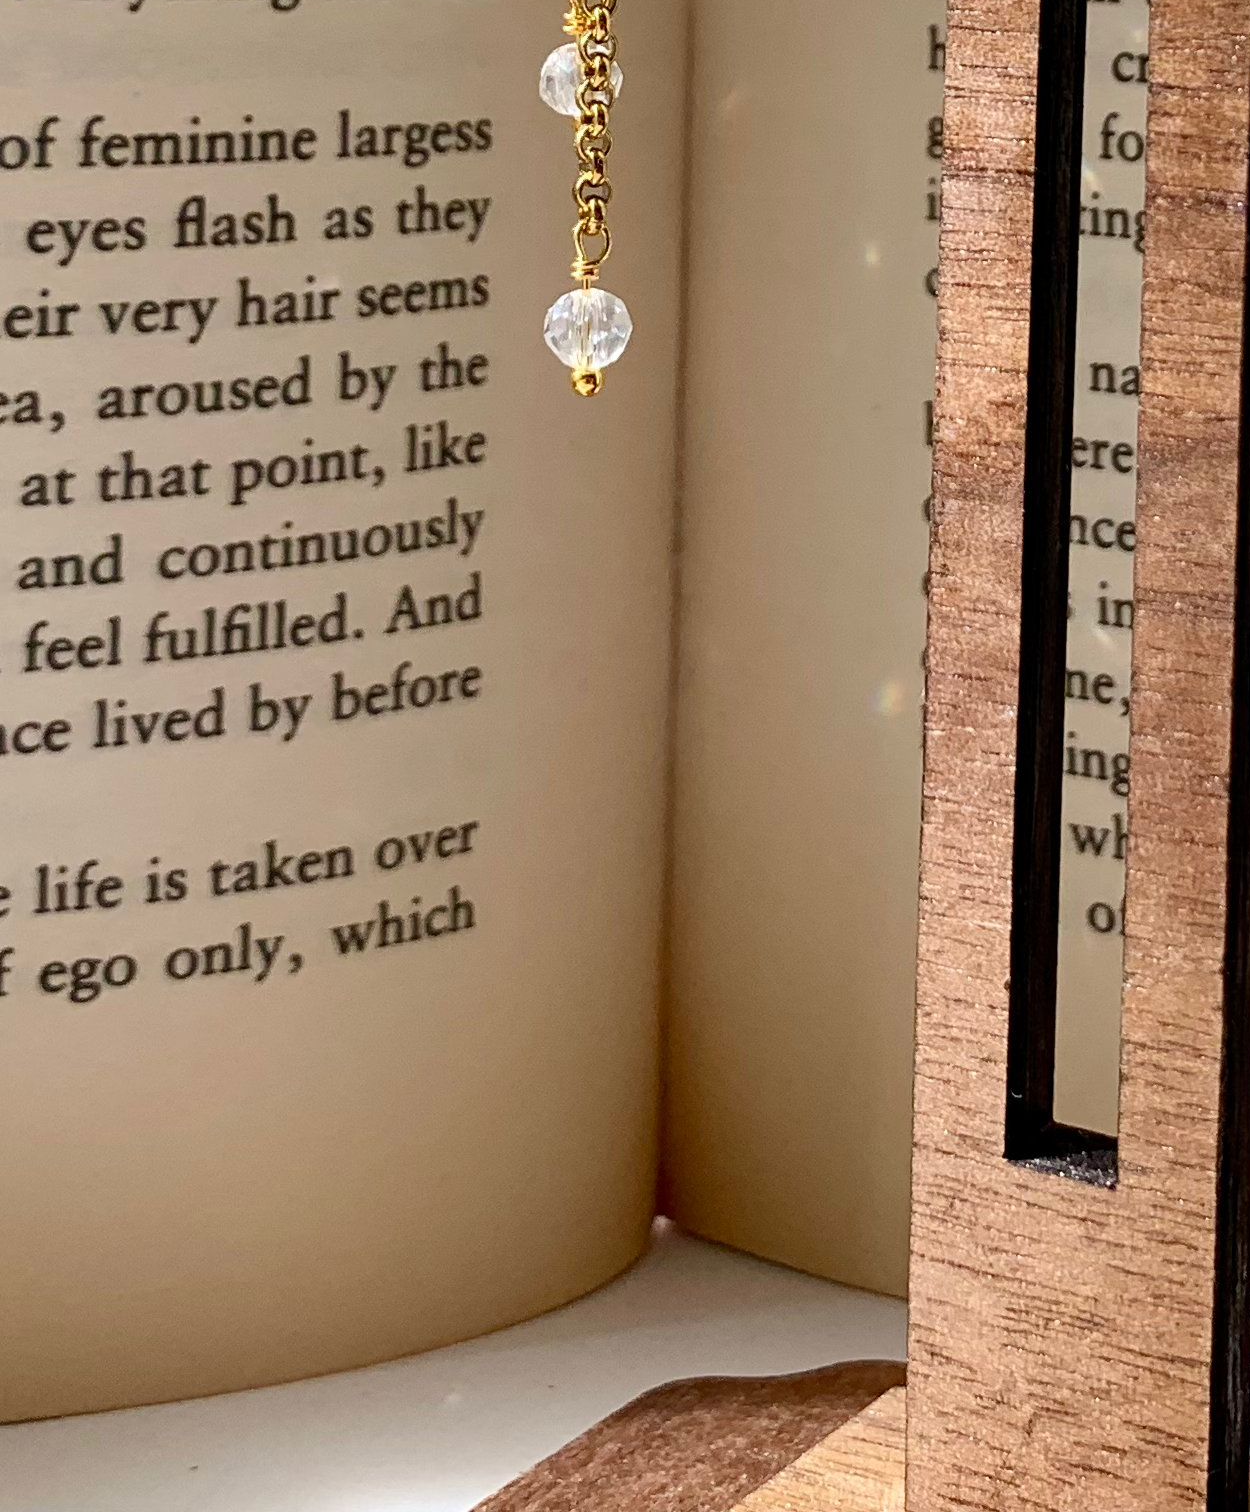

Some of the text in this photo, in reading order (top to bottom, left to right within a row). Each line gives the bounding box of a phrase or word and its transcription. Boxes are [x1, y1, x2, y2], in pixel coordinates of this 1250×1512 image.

[77, 108, 493, 170] feminine largess
[24, 184, 492, 268] eyes flash they
[97, 274, 490, 345] very hair seems
[95, 350, 398, 421] aroused by
[19, 419, 489, 508] at point, like
[15, 496, 485, 592] and continuously
[21, 570, 484, 674] feel fulfilled. And
[91, 660, 483, 750] lived before
[32, 820, 480, 916] life is taken over
[36, 884, 477, 1005] ego only, which
